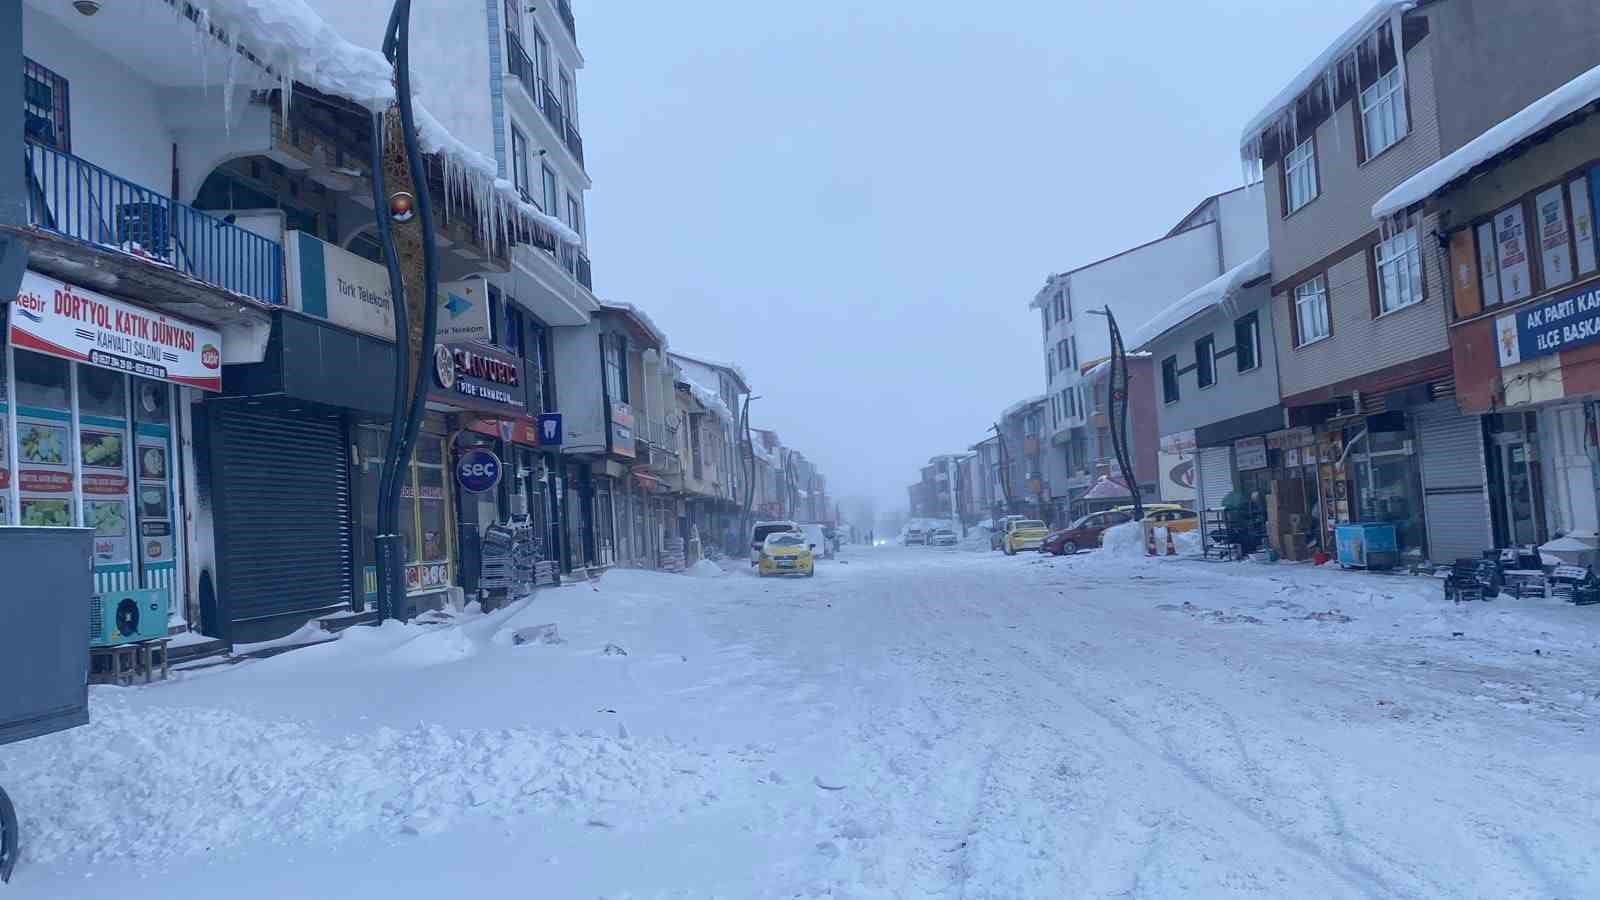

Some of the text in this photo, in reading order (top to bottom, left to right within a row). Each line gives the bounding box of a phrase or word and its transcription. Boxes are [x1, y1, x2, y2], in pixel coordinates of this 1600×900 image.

[337, 277, 356, 298] Türk
[54, 282, 194, 352] DÖRTYOL KATIK DÜNYASI
[1527, 309, 1543, 329] AK
[97, 330, 161, 361] KAHVALTI SALONU
